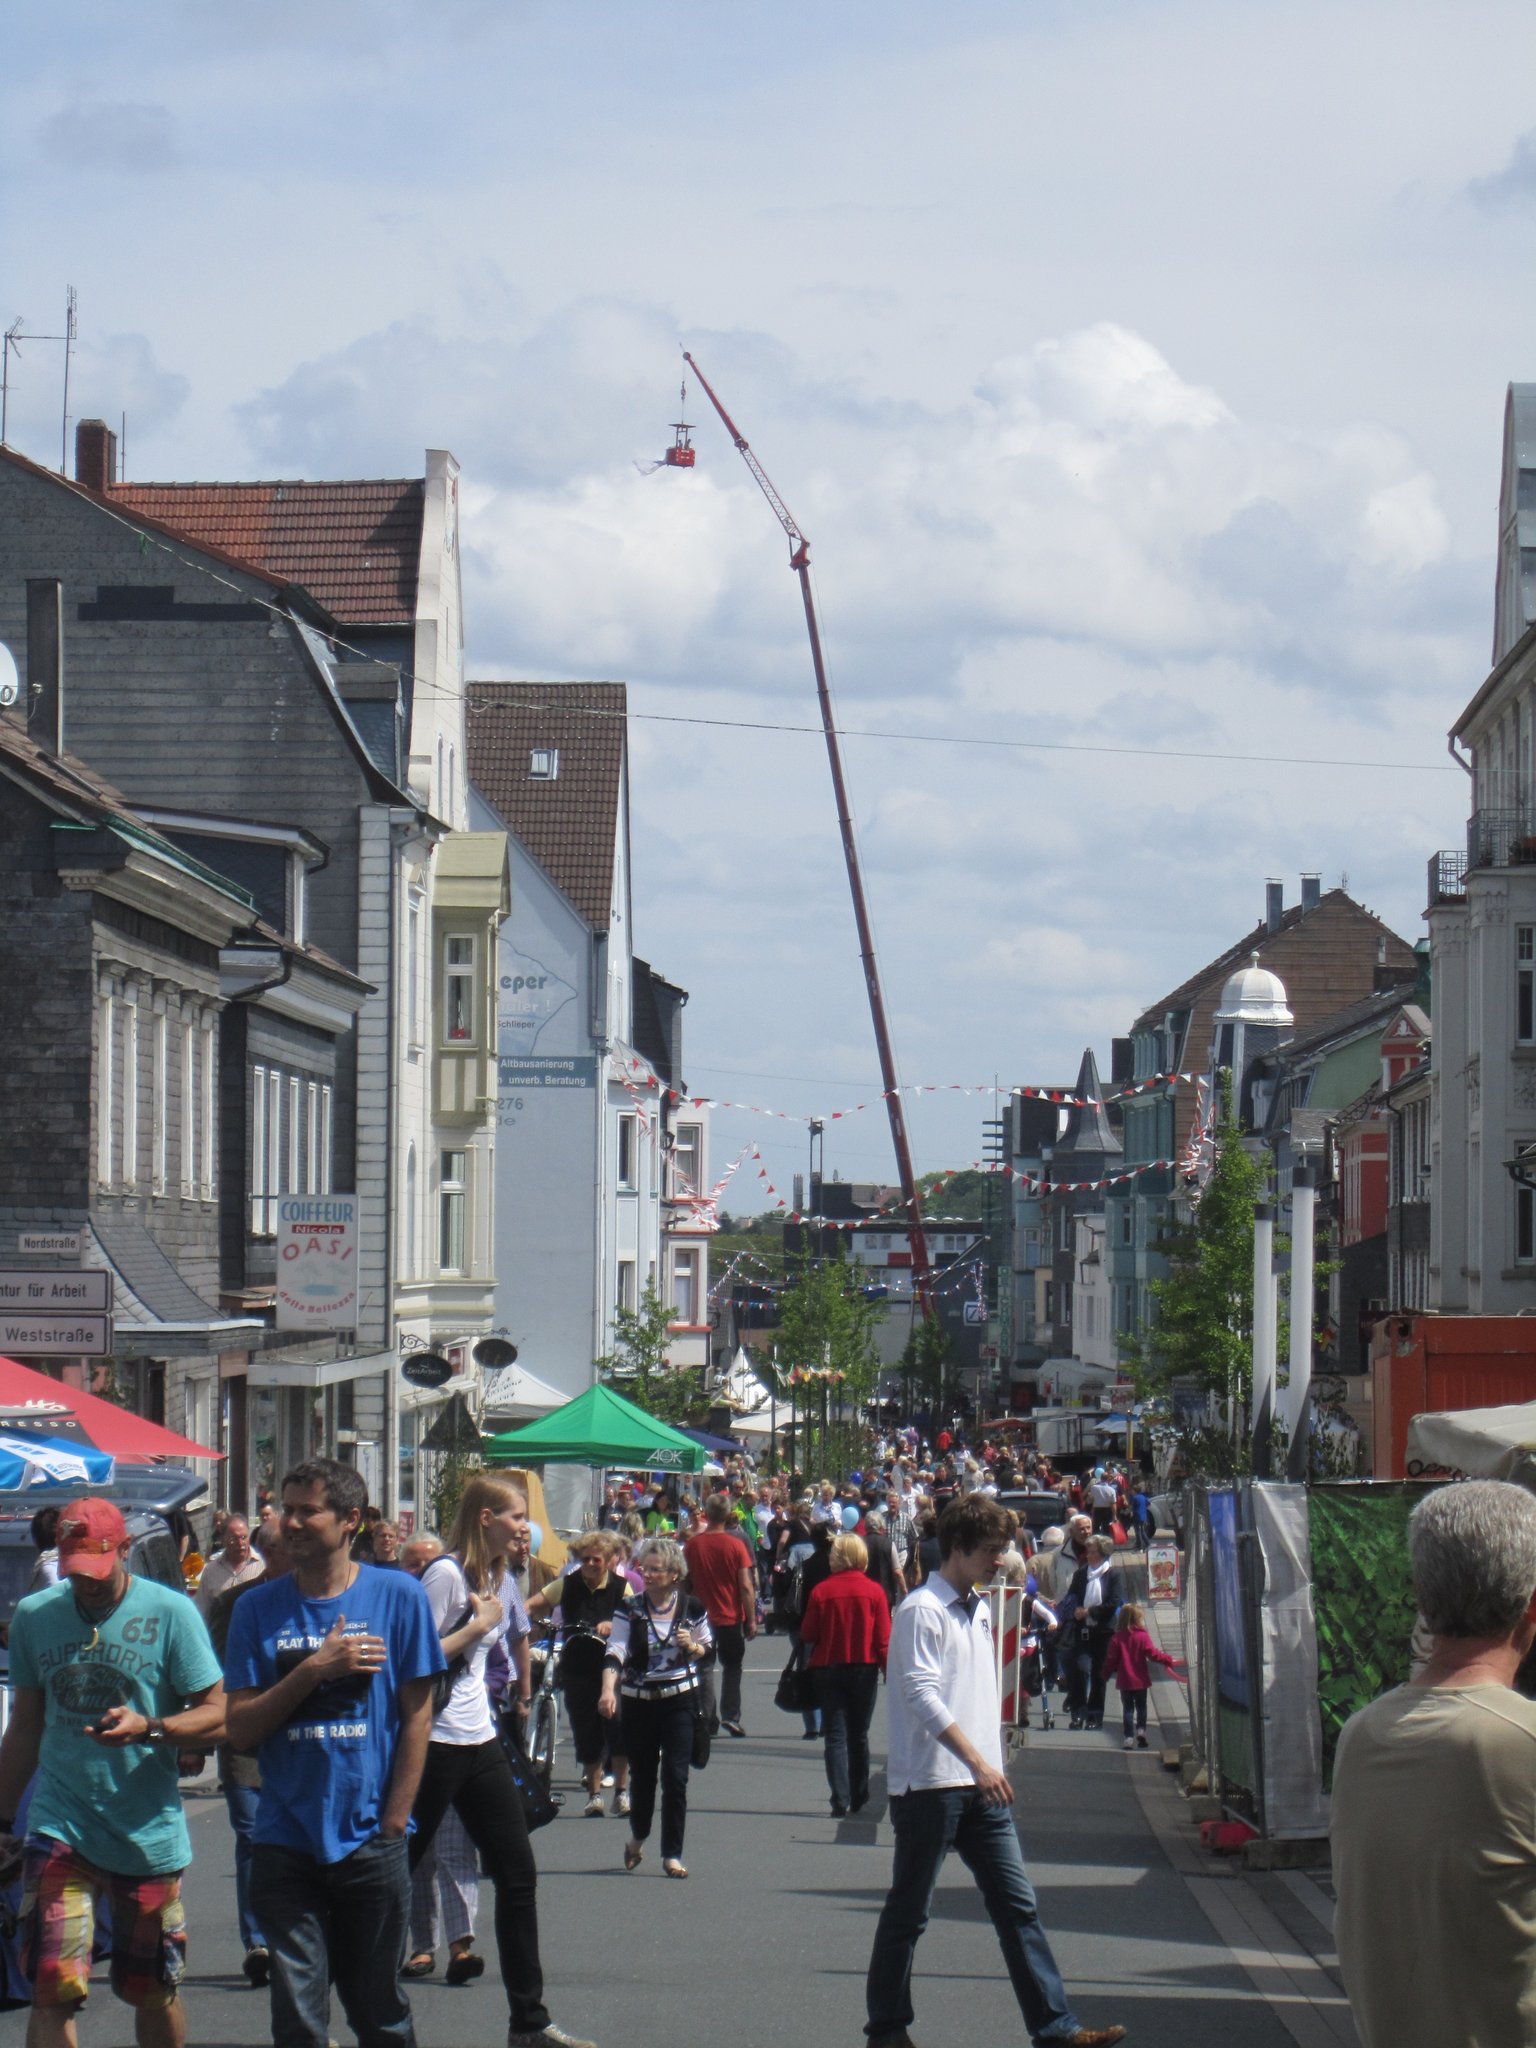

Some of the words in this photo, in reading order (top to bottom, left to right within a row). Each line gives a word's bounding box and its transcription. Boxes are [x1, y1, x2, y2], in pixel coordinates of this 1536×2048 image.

[500, 975, 547, 994] eper
[501, 1059, 575, 1071] Altbausanierung
[508, 1075, 543, 1085] unverb.
[544, 1075, 586, 1087] Beratung
[281, 1201, 353, 1223] COIFFEUR
[295, 1225, 341, 1234] Nicola
[24, 1236, 77, 1250] Nordstraße
[282, 1237, 353, 1261] OASI
[28, 1282, 45, 1298] für
[51, 1283, 87, 1298] Arbeit
[5, 1327, 94, 1342] Weststraße
[646, 1448, 683, 1464] AOK
[122, 1617, 160, 1645] 65
[277, 1636, 304, 1650] PLAY
[38, 1641, 153, 1677] SUPERDRY
[287, 1729, 300, 1741] ON
[304, 1726, 325, 1739] THE
[329, 1723, 367, 1738] RADIO!
